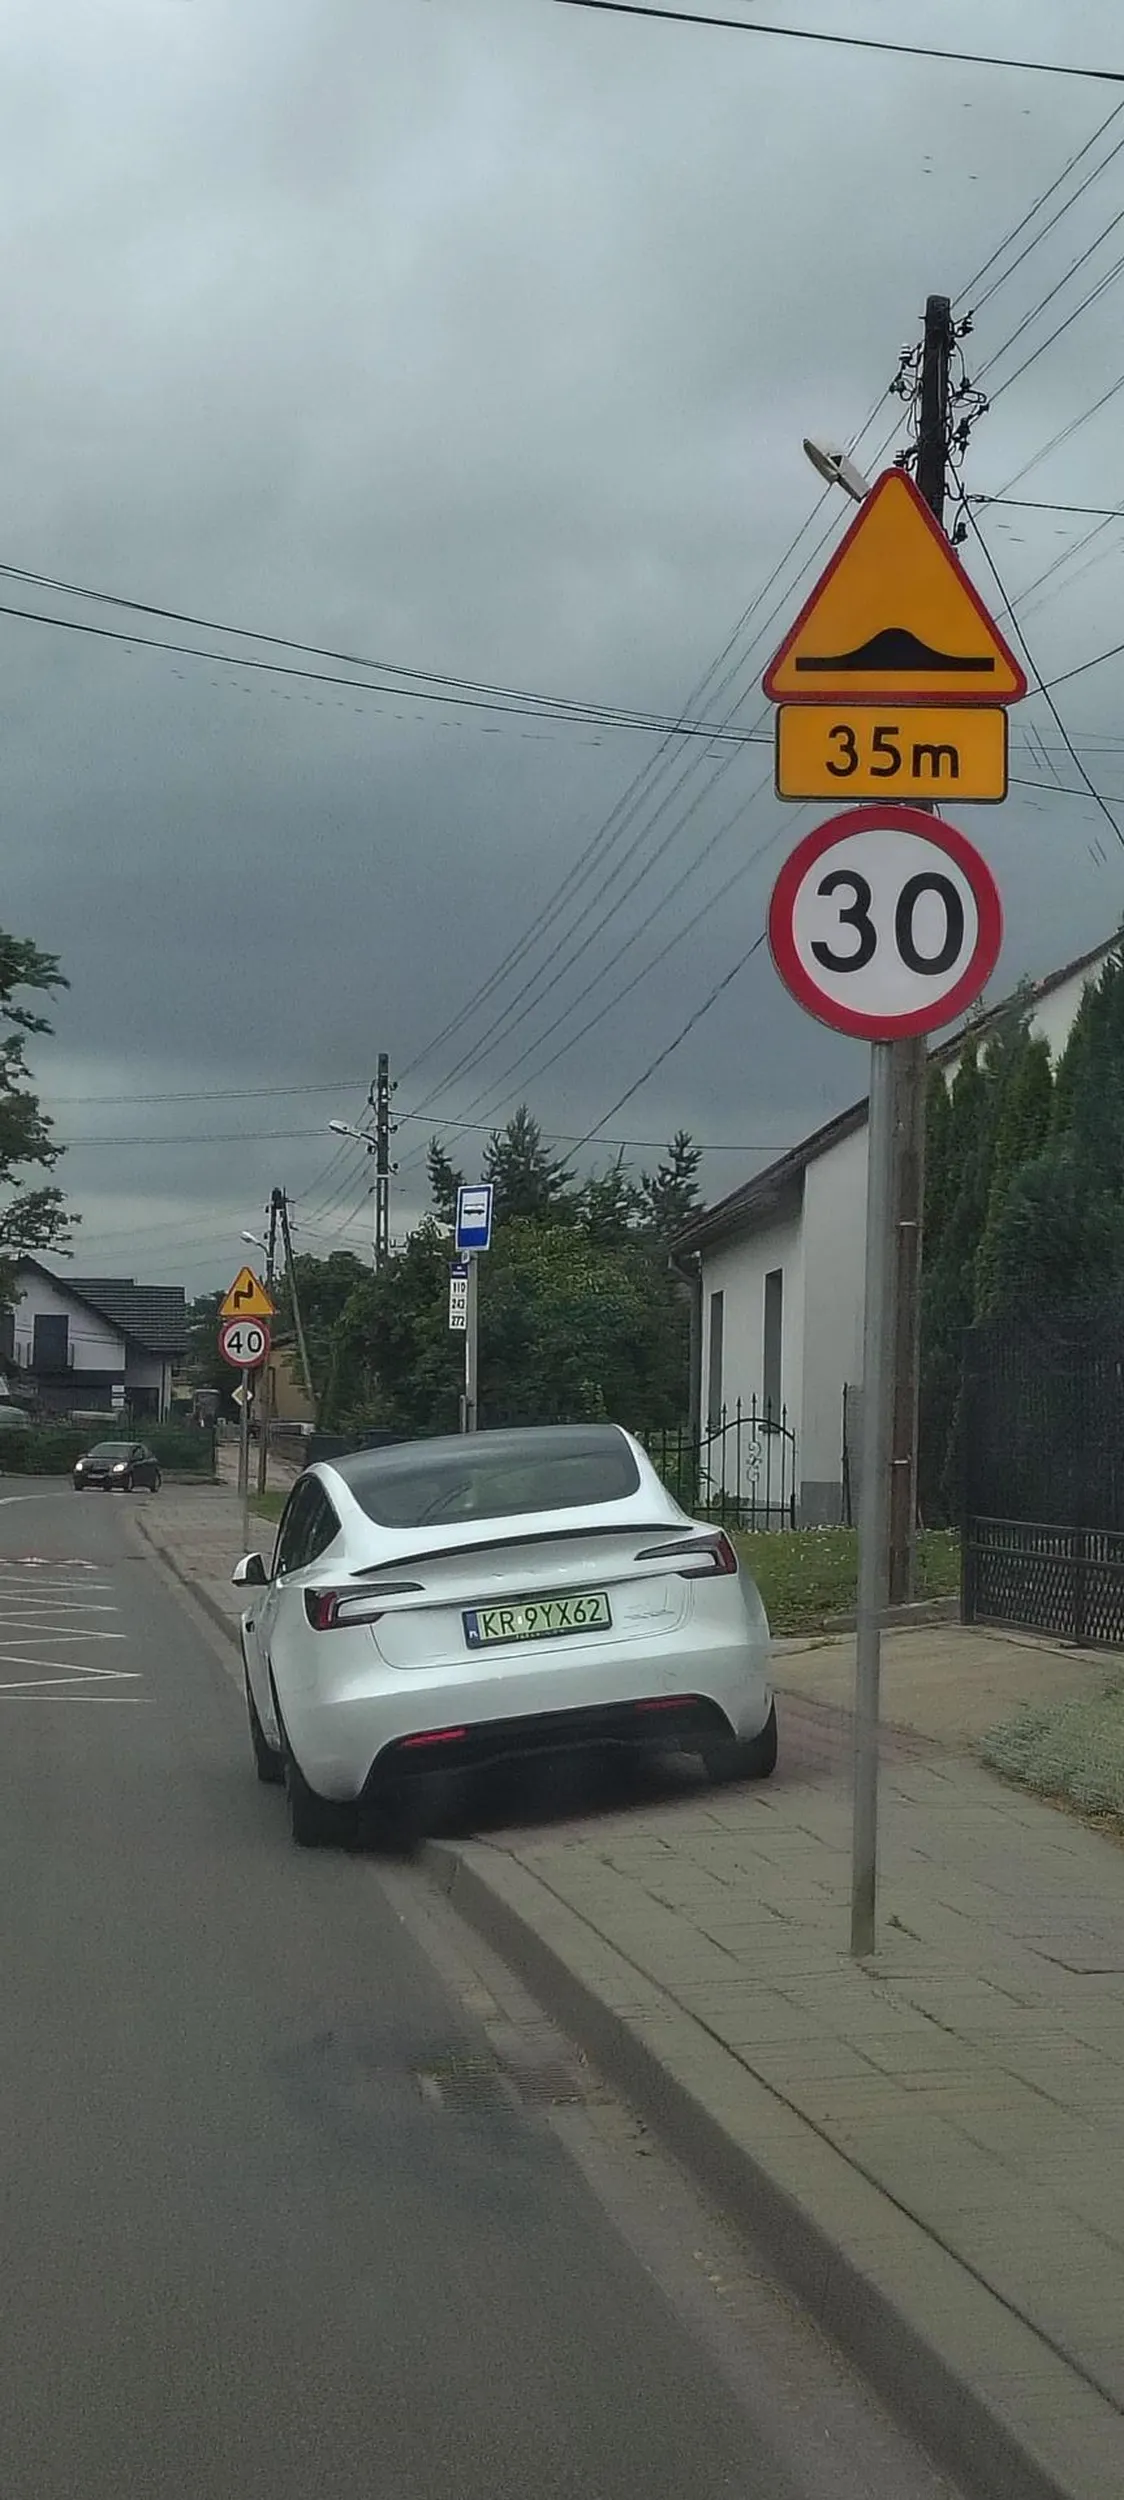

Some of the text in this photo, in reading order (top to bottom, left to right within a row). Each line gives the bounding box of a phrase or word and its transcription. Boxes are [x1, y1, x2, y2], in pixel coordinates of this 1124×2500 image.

[825, 725, 959, 778] 35m
[811, 869, 965, 975] 30
[227, 1331, 262, 1353] 40
[482, 1610, 516, 1638] KR
[524, 1599, 603, 1630] 9YX62
